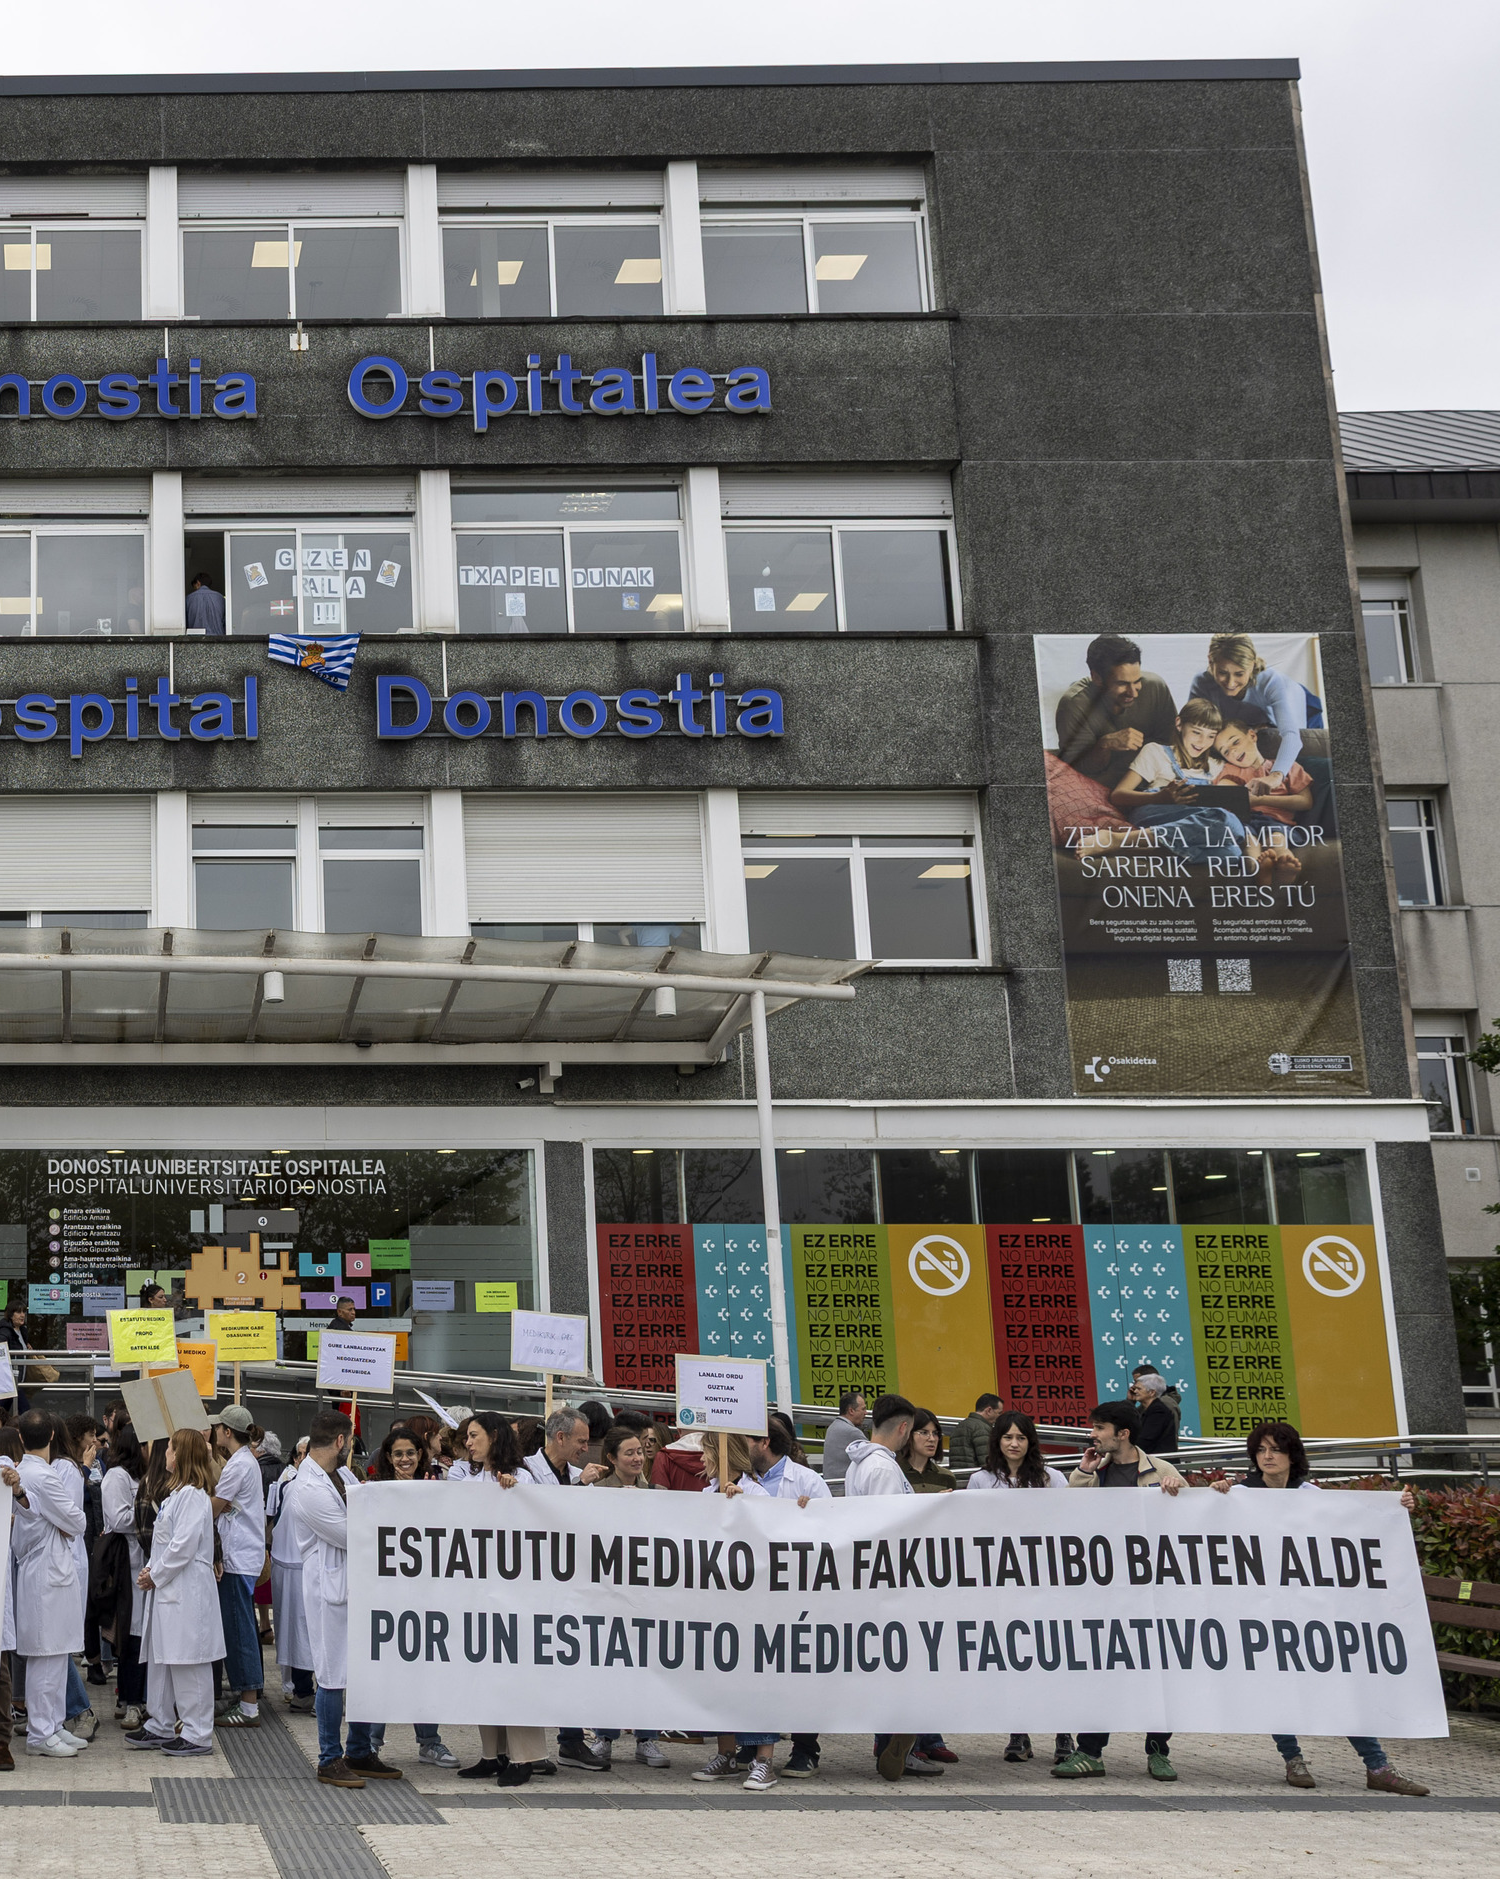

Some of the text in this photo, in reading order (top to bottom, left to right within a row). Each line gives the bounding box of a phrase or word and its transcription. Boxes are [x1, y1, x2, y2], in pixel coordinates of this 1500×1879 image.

[347, 352, 772, 434] Ospitalea
[460, 568, 652, 586] TXAPEL DUNAK
[376, 673, 785, 740] Donostia
[1064, 826, 1189, 848] ZEU ZARA
[1205, 825, 1328, 849] LA MEJOR
[1081, 856, 1192, 878] SARERIK
[1207, 856, 1259, 877] RED
[1103, 885, 1195, 908] ONENA
[1210, 881, 1315, 907] ERES TÚ
[1109, 1056, 1156, 1064] Osakidetza
[48, 1159, 386, 1175] DONOSTIA UNIBERTSITATE OSPITALEA
[609, 1235, 681, 1247] EZ ERRE
[804, 1235, 876, 1247] EZ ERRE
[999, 1235, 1072, 1248] EZ ERRE
[1195, 1235, 1269, 1248] EZ ERRE
[609, 1250, 682, 1261] NO FUMAR
[804, 1250, 877, 1261] NO FUMAR
[1000, 1251, 1073, 1262] NO FUMAR
[1196, 1251, 1271, 1262] NO FUMAR
[238, 1273, 245, 1284] 2
[377, 1289, 385, 1300] P
[378, 1527, 1387, 1591] ESTATUTU MEDIKO ETA FAKULTATIBO BATEN ALDE
[371, 1610, 1407, 1675] POR UN ESTATUTO MÉDICO Y FACULTATIVO PROPIO
